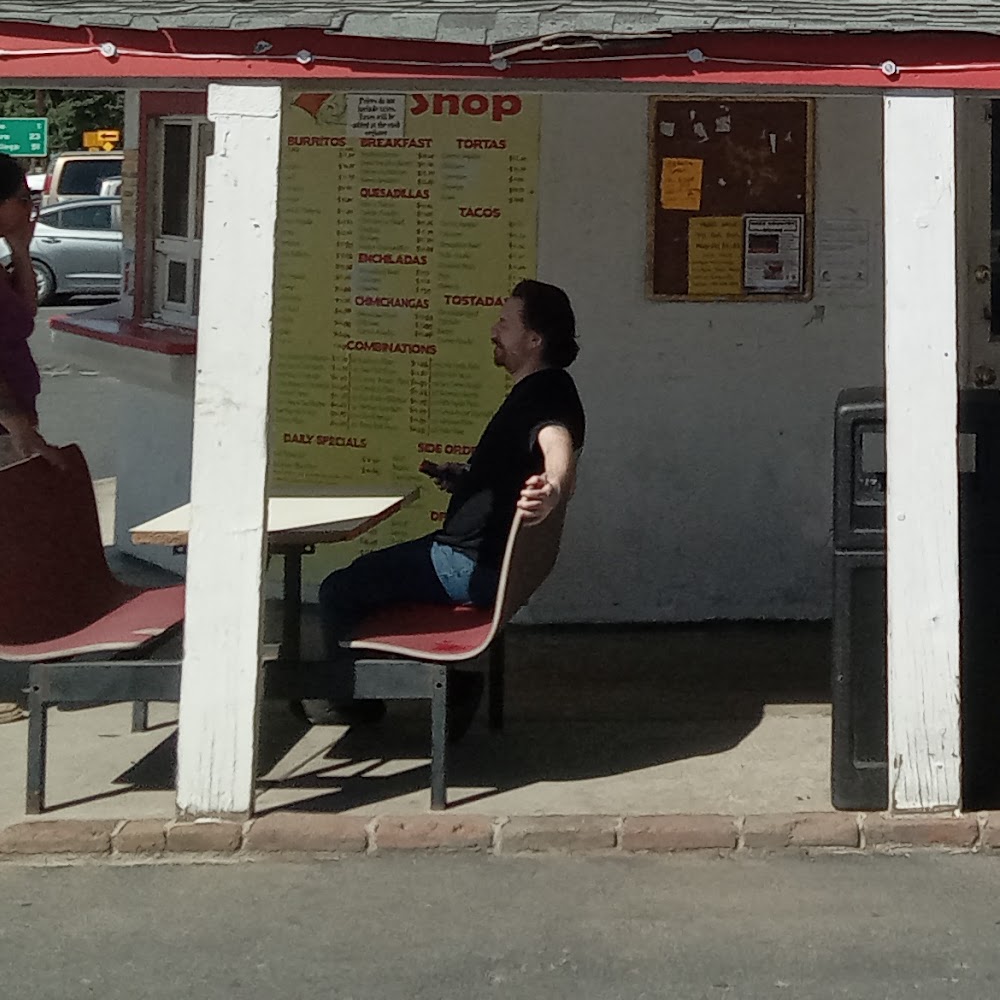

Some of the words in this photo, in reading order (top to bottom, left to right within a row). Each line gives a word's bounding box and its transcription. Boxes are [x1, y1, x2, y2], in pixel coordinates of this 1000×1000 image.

[287, 136, 347, 147] BURRITOS
[359, 138, 433, 149] BREAKFAST
[456, 139, 507, 149] TORTAS
[360, 188, 430, 199] QUESADILLAS
[459, 207, 501, 218] TACOS
[358, 254, 427, 266] ENCHILADAS
[355, 296, 429, 310] CHIMICHANGAS
[346, 340, 437, 355] COMBINATIONS
[283, 433, 314, 445] DAILY
[316, 435, 367, 448] SPECIALS
[417, 443, 442, 454] SIDE
